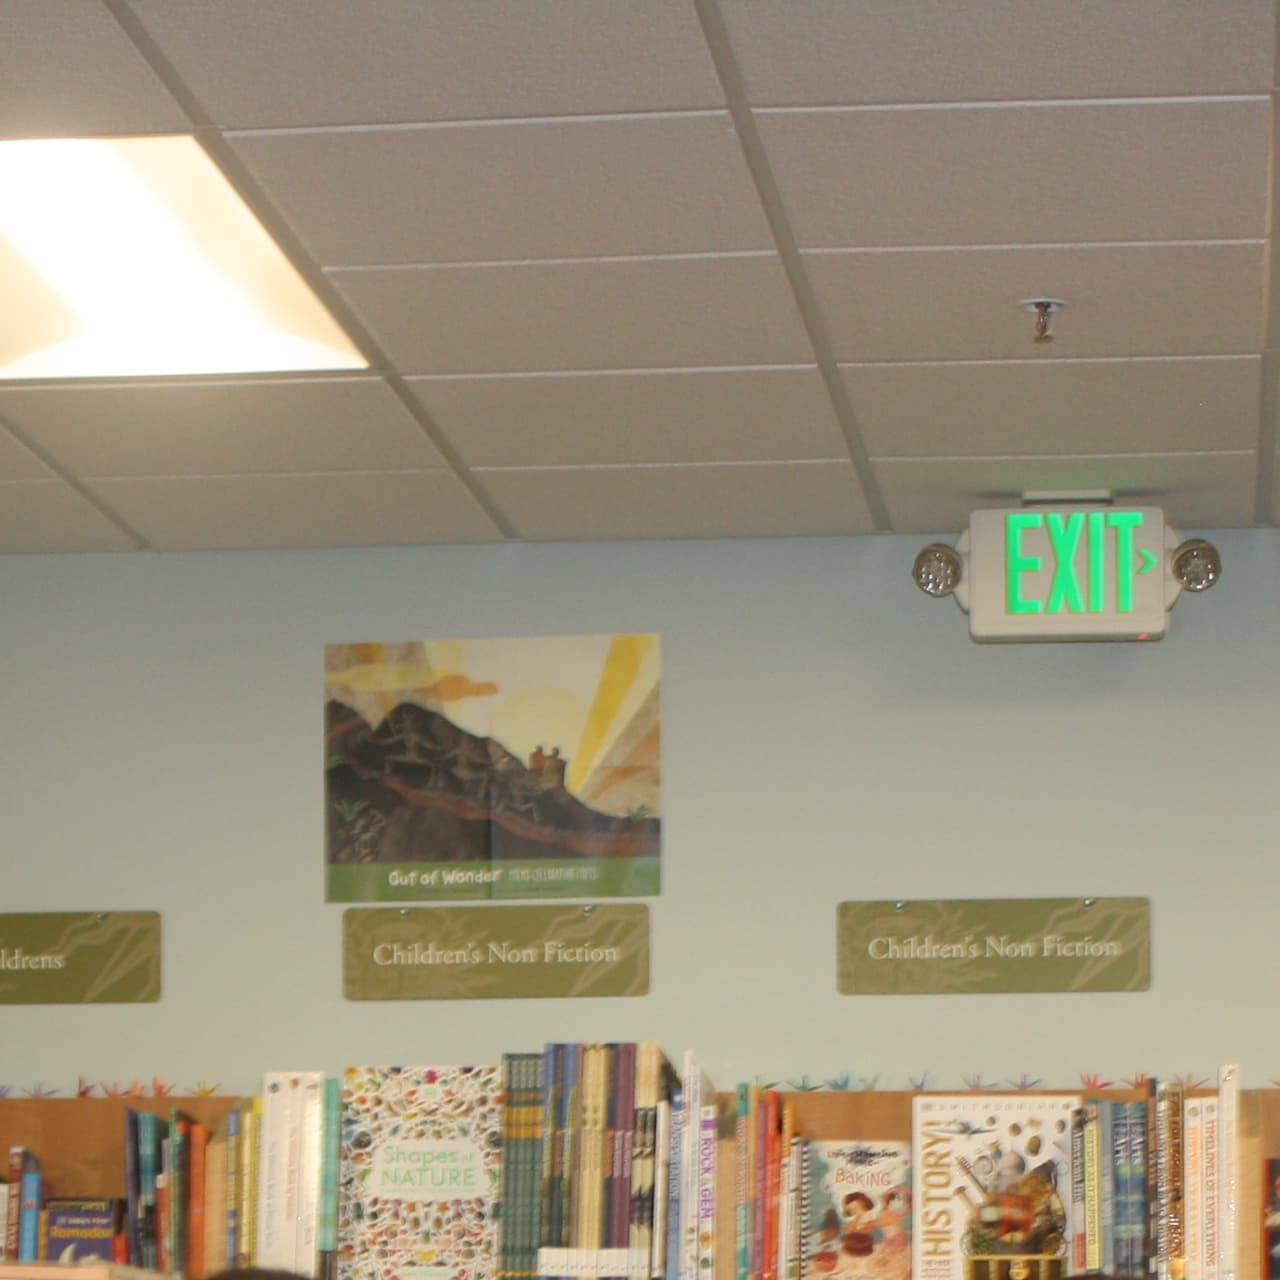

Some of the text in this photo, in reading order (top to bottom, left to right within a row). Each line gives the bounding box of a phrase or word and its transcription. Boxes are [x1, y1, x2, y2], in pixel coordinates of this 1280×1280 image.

[1006, 512, 1144, 614] EXIT
[388, 869, 417, 886] Out
[420, 869, 438, 886] of
[443, 868, 503, 885] Wonder
[373, 941, 619, 966] Children's Non Fiction
[868, 935, 1121, 960] Children's Non Fiction
[383, 1146, 458, 1166] Shapes
[1205, 1120, 1218, 1178] TIMELINES
[382, 1168, 477, 1186] NATURE
[700, 1137, 713, 1219] ROCK GEM
[1206, 1196, 1218, 1267] EVERYTHING
